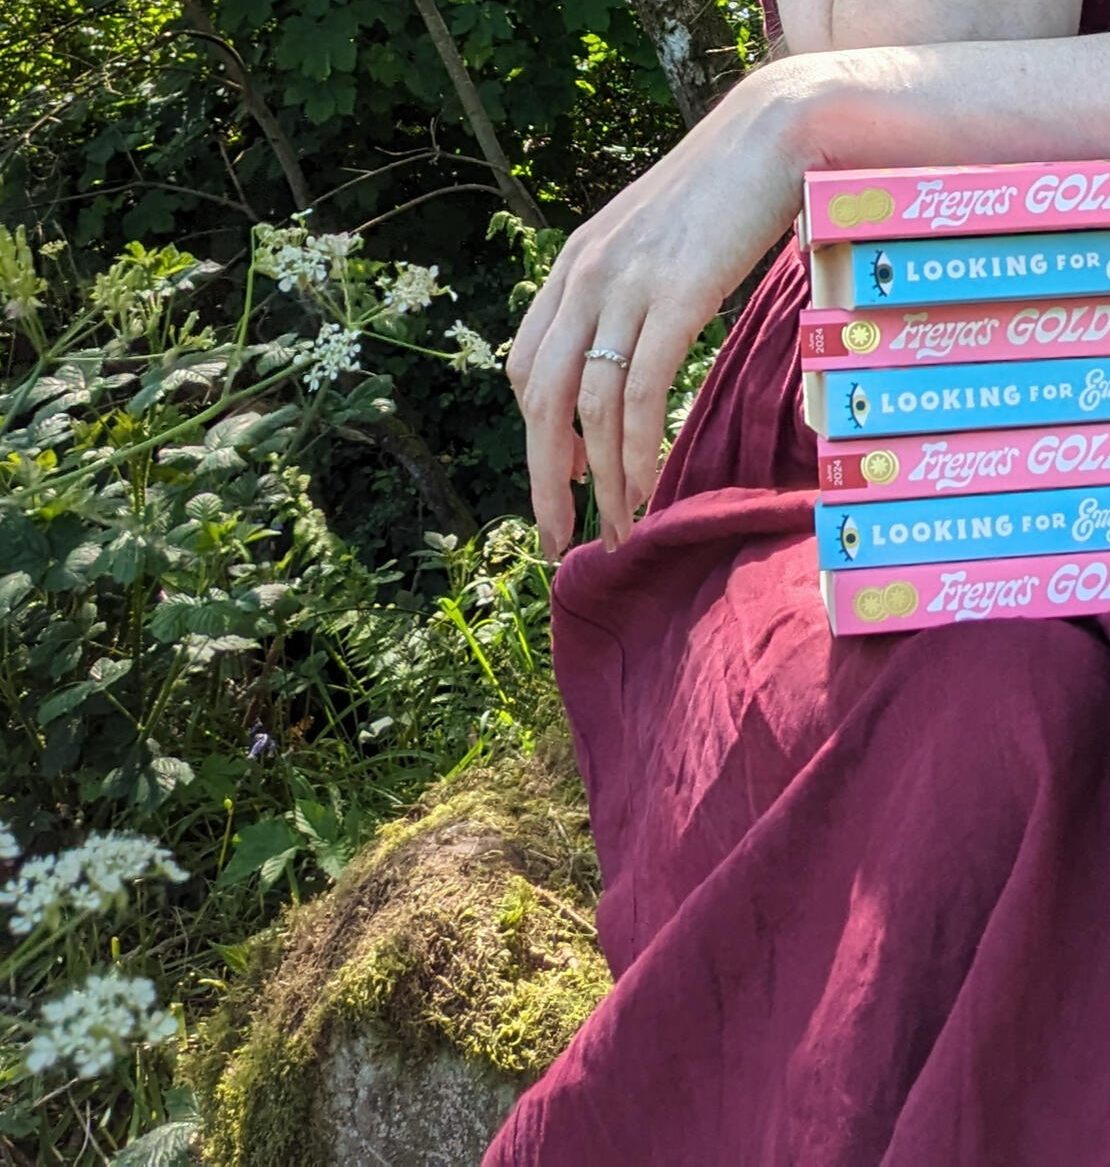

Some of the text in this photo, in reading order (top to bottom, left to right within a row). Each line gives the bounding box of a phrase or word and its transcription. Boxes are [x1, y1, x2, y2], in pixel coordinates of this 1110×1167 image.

[903, 179, 1017, 229] Freya's
[906, 253, 1047, 281] LOOKING
[1057, 252, 1100, 270] FOR
[815, 328, 824, 353] 2024
[889, 312, 999, 359] Freya's
[882, 385, 1021, 413] LOOKING
[1030, 383, 1073, 401] FOR
[833, 460, 843, 486] 2024
[908, 441, 1020, 491] Freya's
[872, 515, 1013, 545] LOOKING
[1022, 513, 1066, 532] FOR
[927, 571, 1040, 622] Freya's
